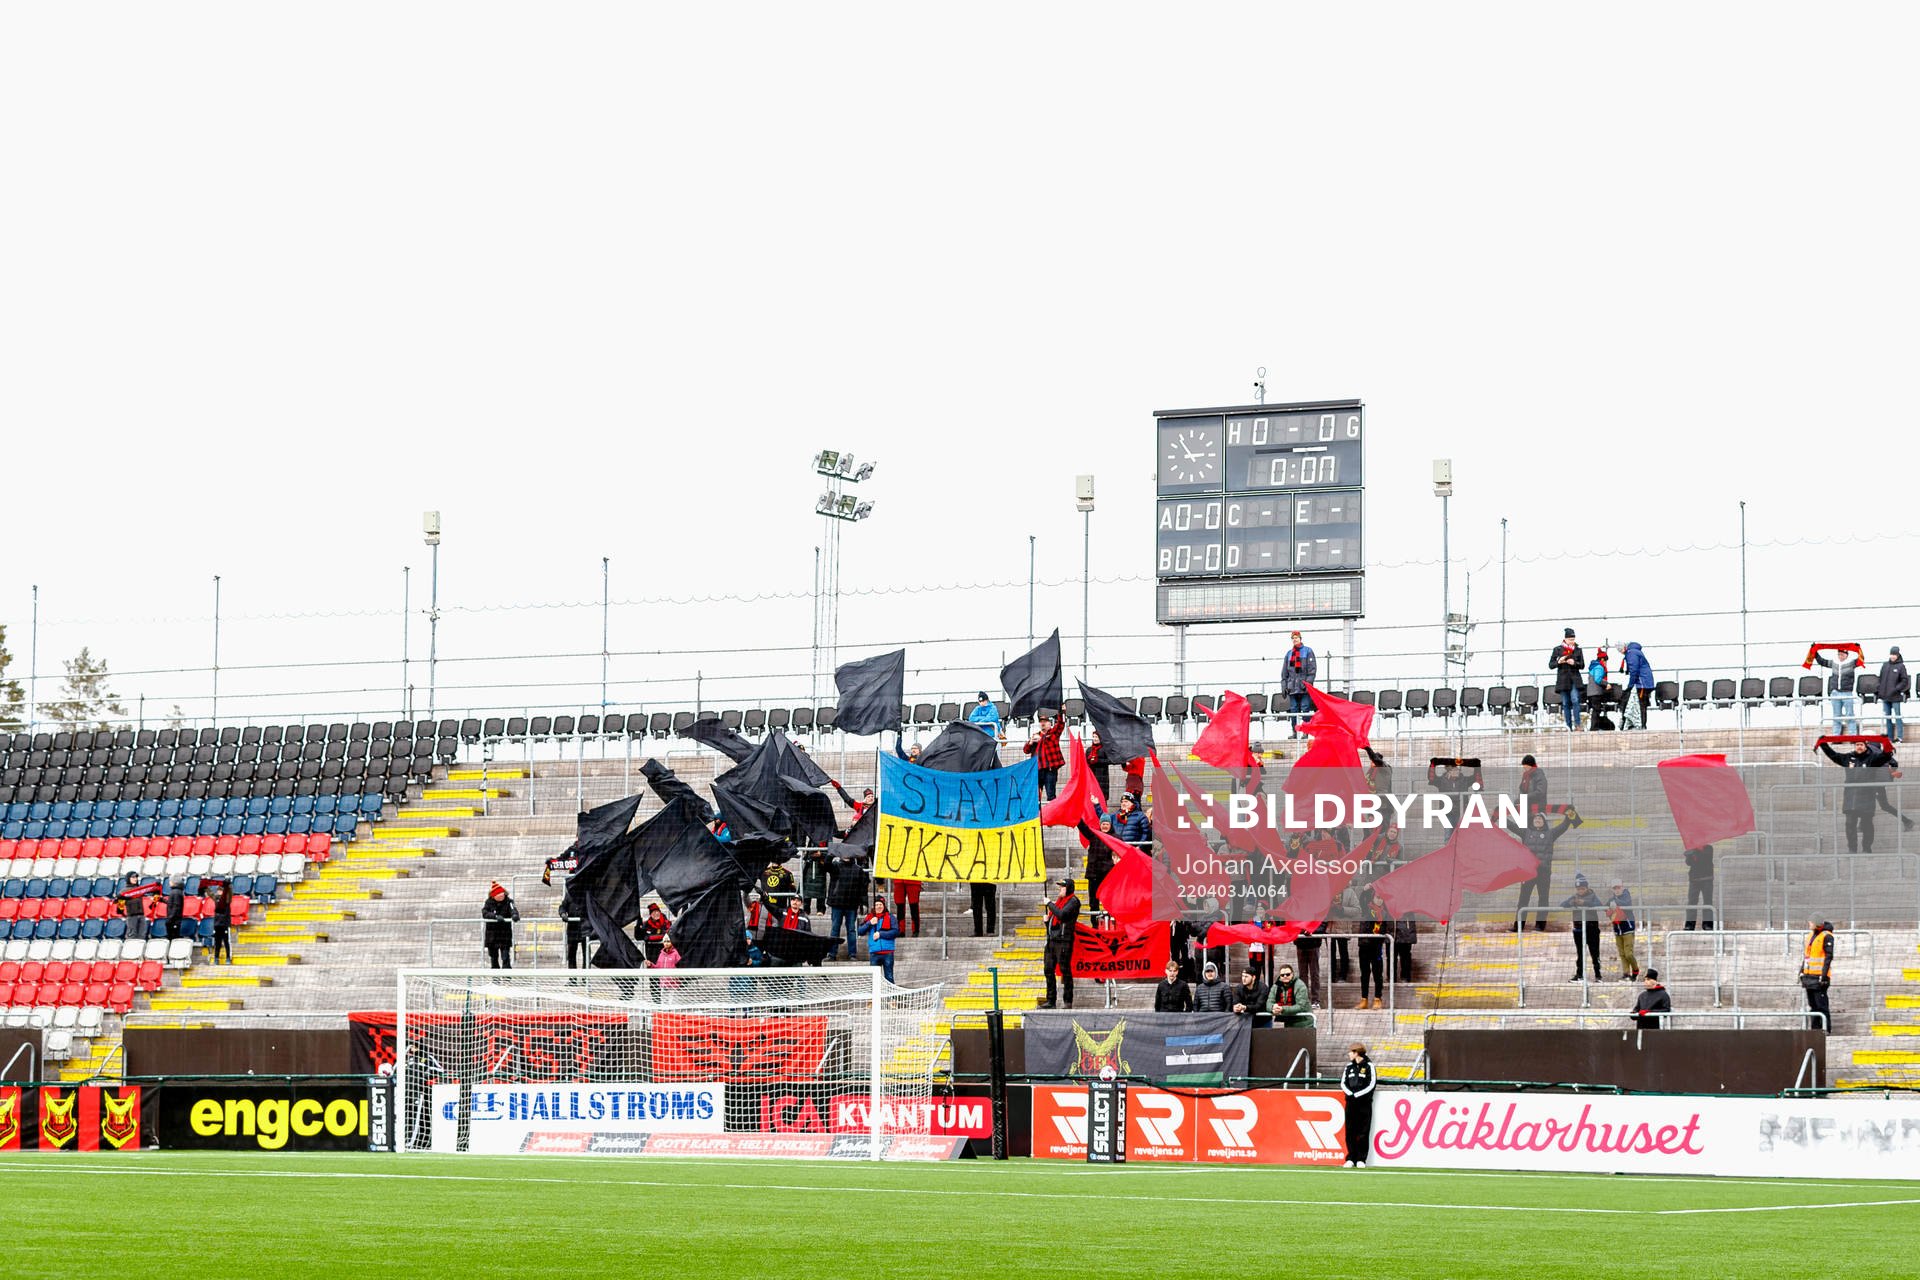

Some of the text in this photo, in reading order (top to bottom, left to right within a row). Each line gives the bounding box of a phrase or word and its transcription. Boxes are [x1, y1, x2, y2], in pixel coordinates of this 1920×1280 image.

[1228, 422, 1241, 444] H
[1347, 416, 1359, 437] G
[900, 773, 1026, 822] SLAVA
[886, 824, 1041, 880] UKRAINI
[190, 1098, 369, 1149] engco
[371, 1087, 387, 1145] SELECT
[509, 1091, 714, 1121] HALLSTRÖMS
[760, 1095, 983, 1133] ICA KVANTUM
[1093, 1091, 1110, 1153] SELECT
[1117, 1091, 1126, 1153] SELECT
[1374, 1098, 1704, 1159] Mäklarhuset
